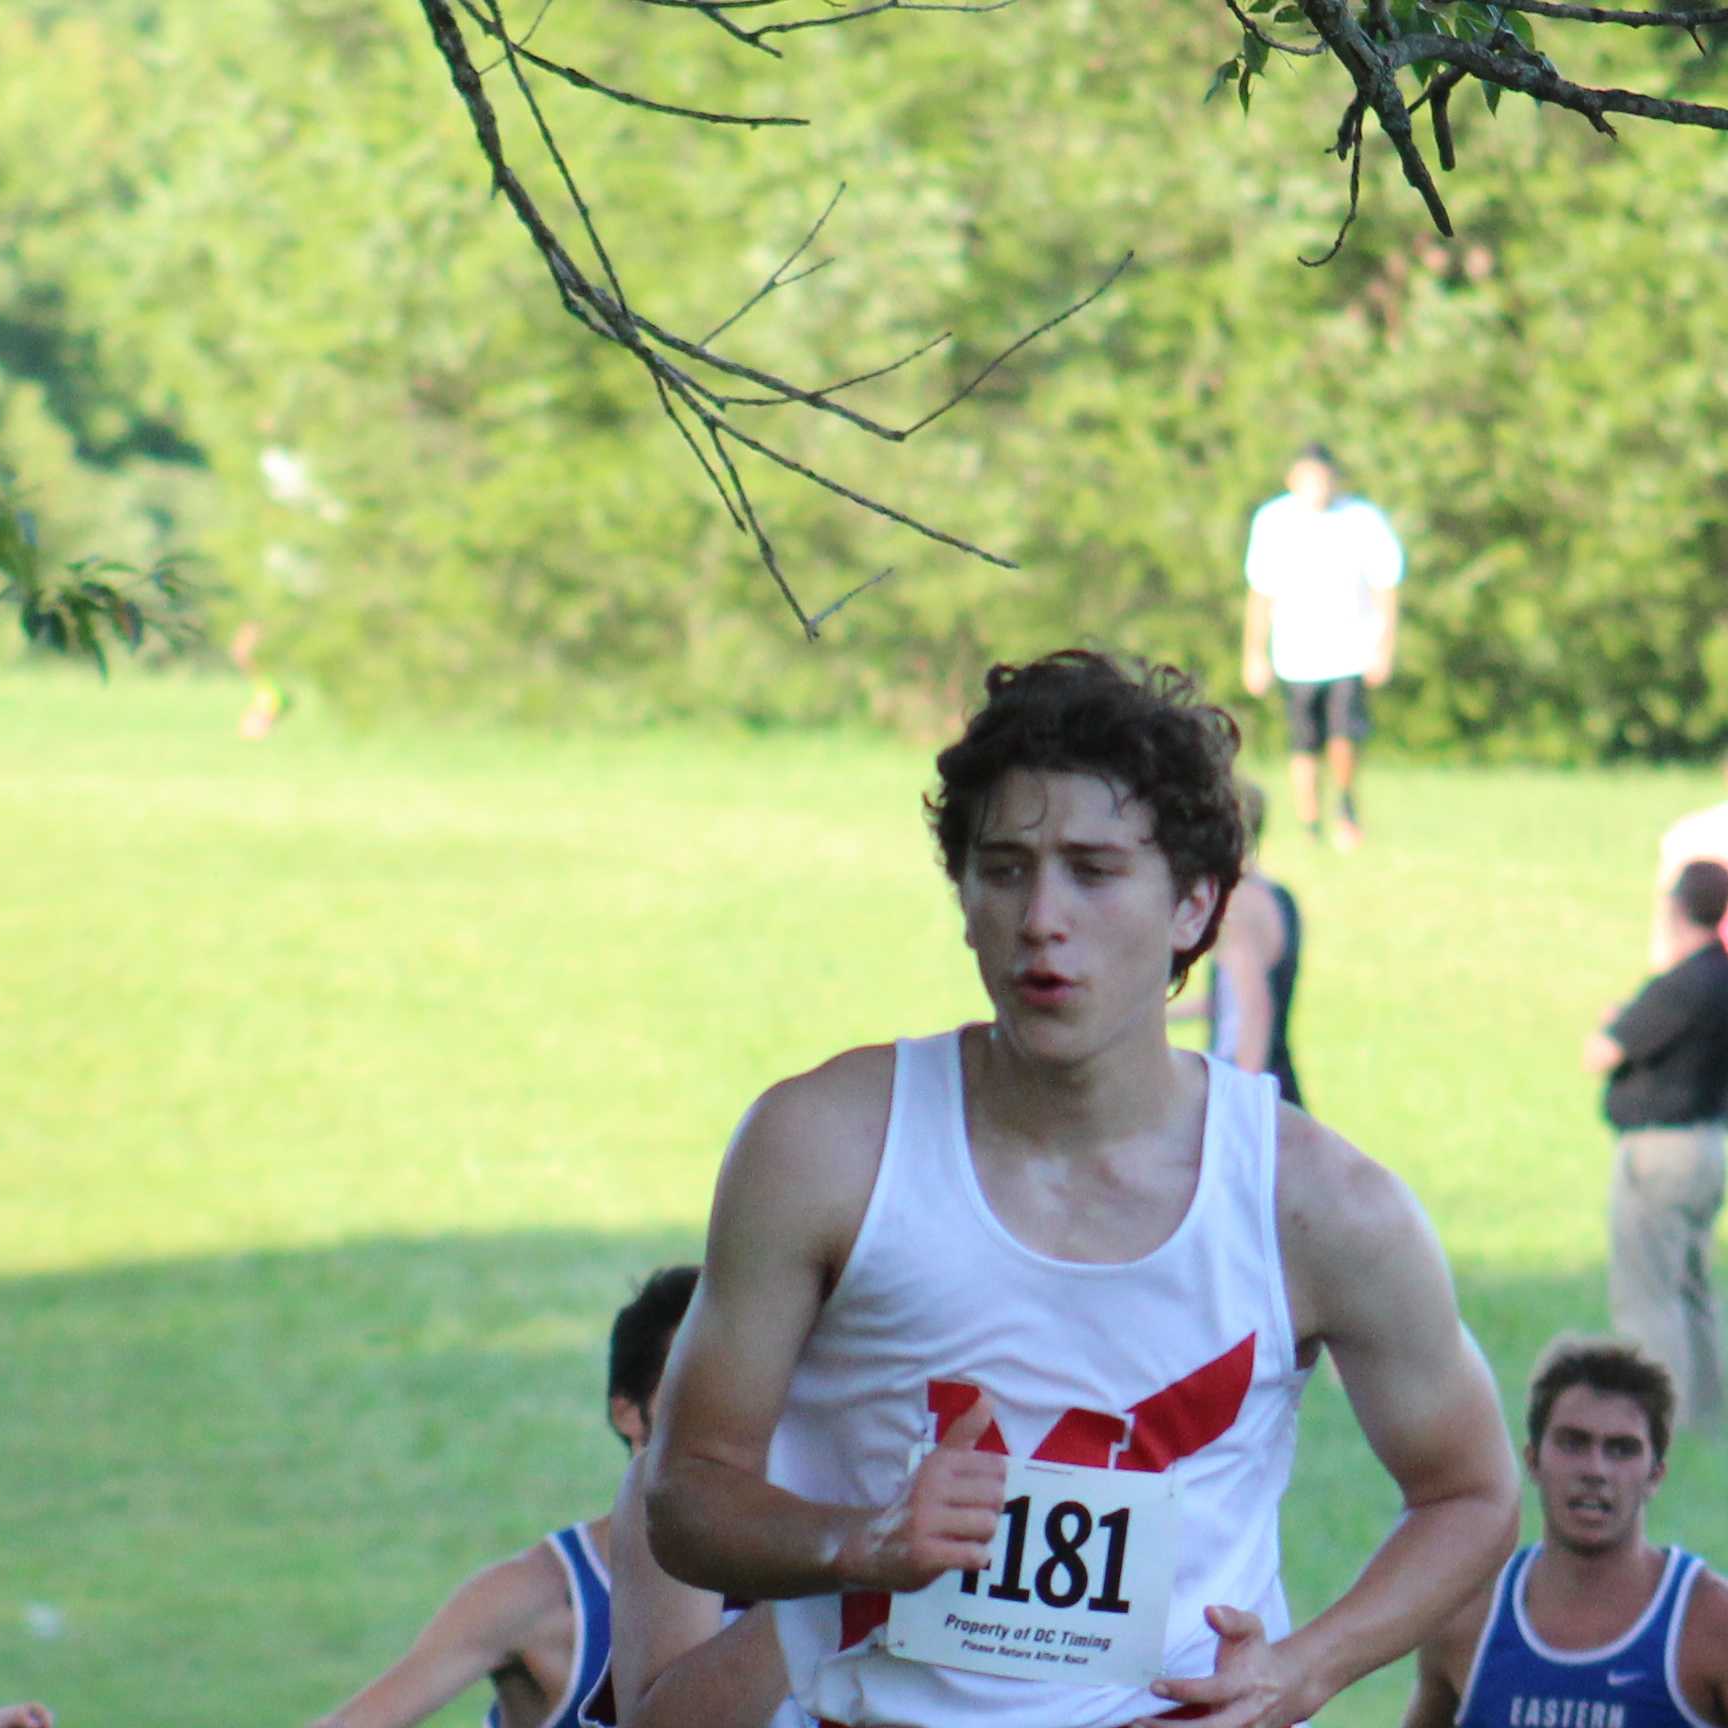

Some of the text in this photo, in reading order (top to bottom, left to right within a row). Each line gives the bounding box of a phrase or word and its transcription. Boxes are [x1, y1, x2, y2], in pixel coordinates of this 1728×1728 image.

[961, 1495, 1130, 1614] 181
[944, 1613, 1112, 1650] Property of DC Timing
